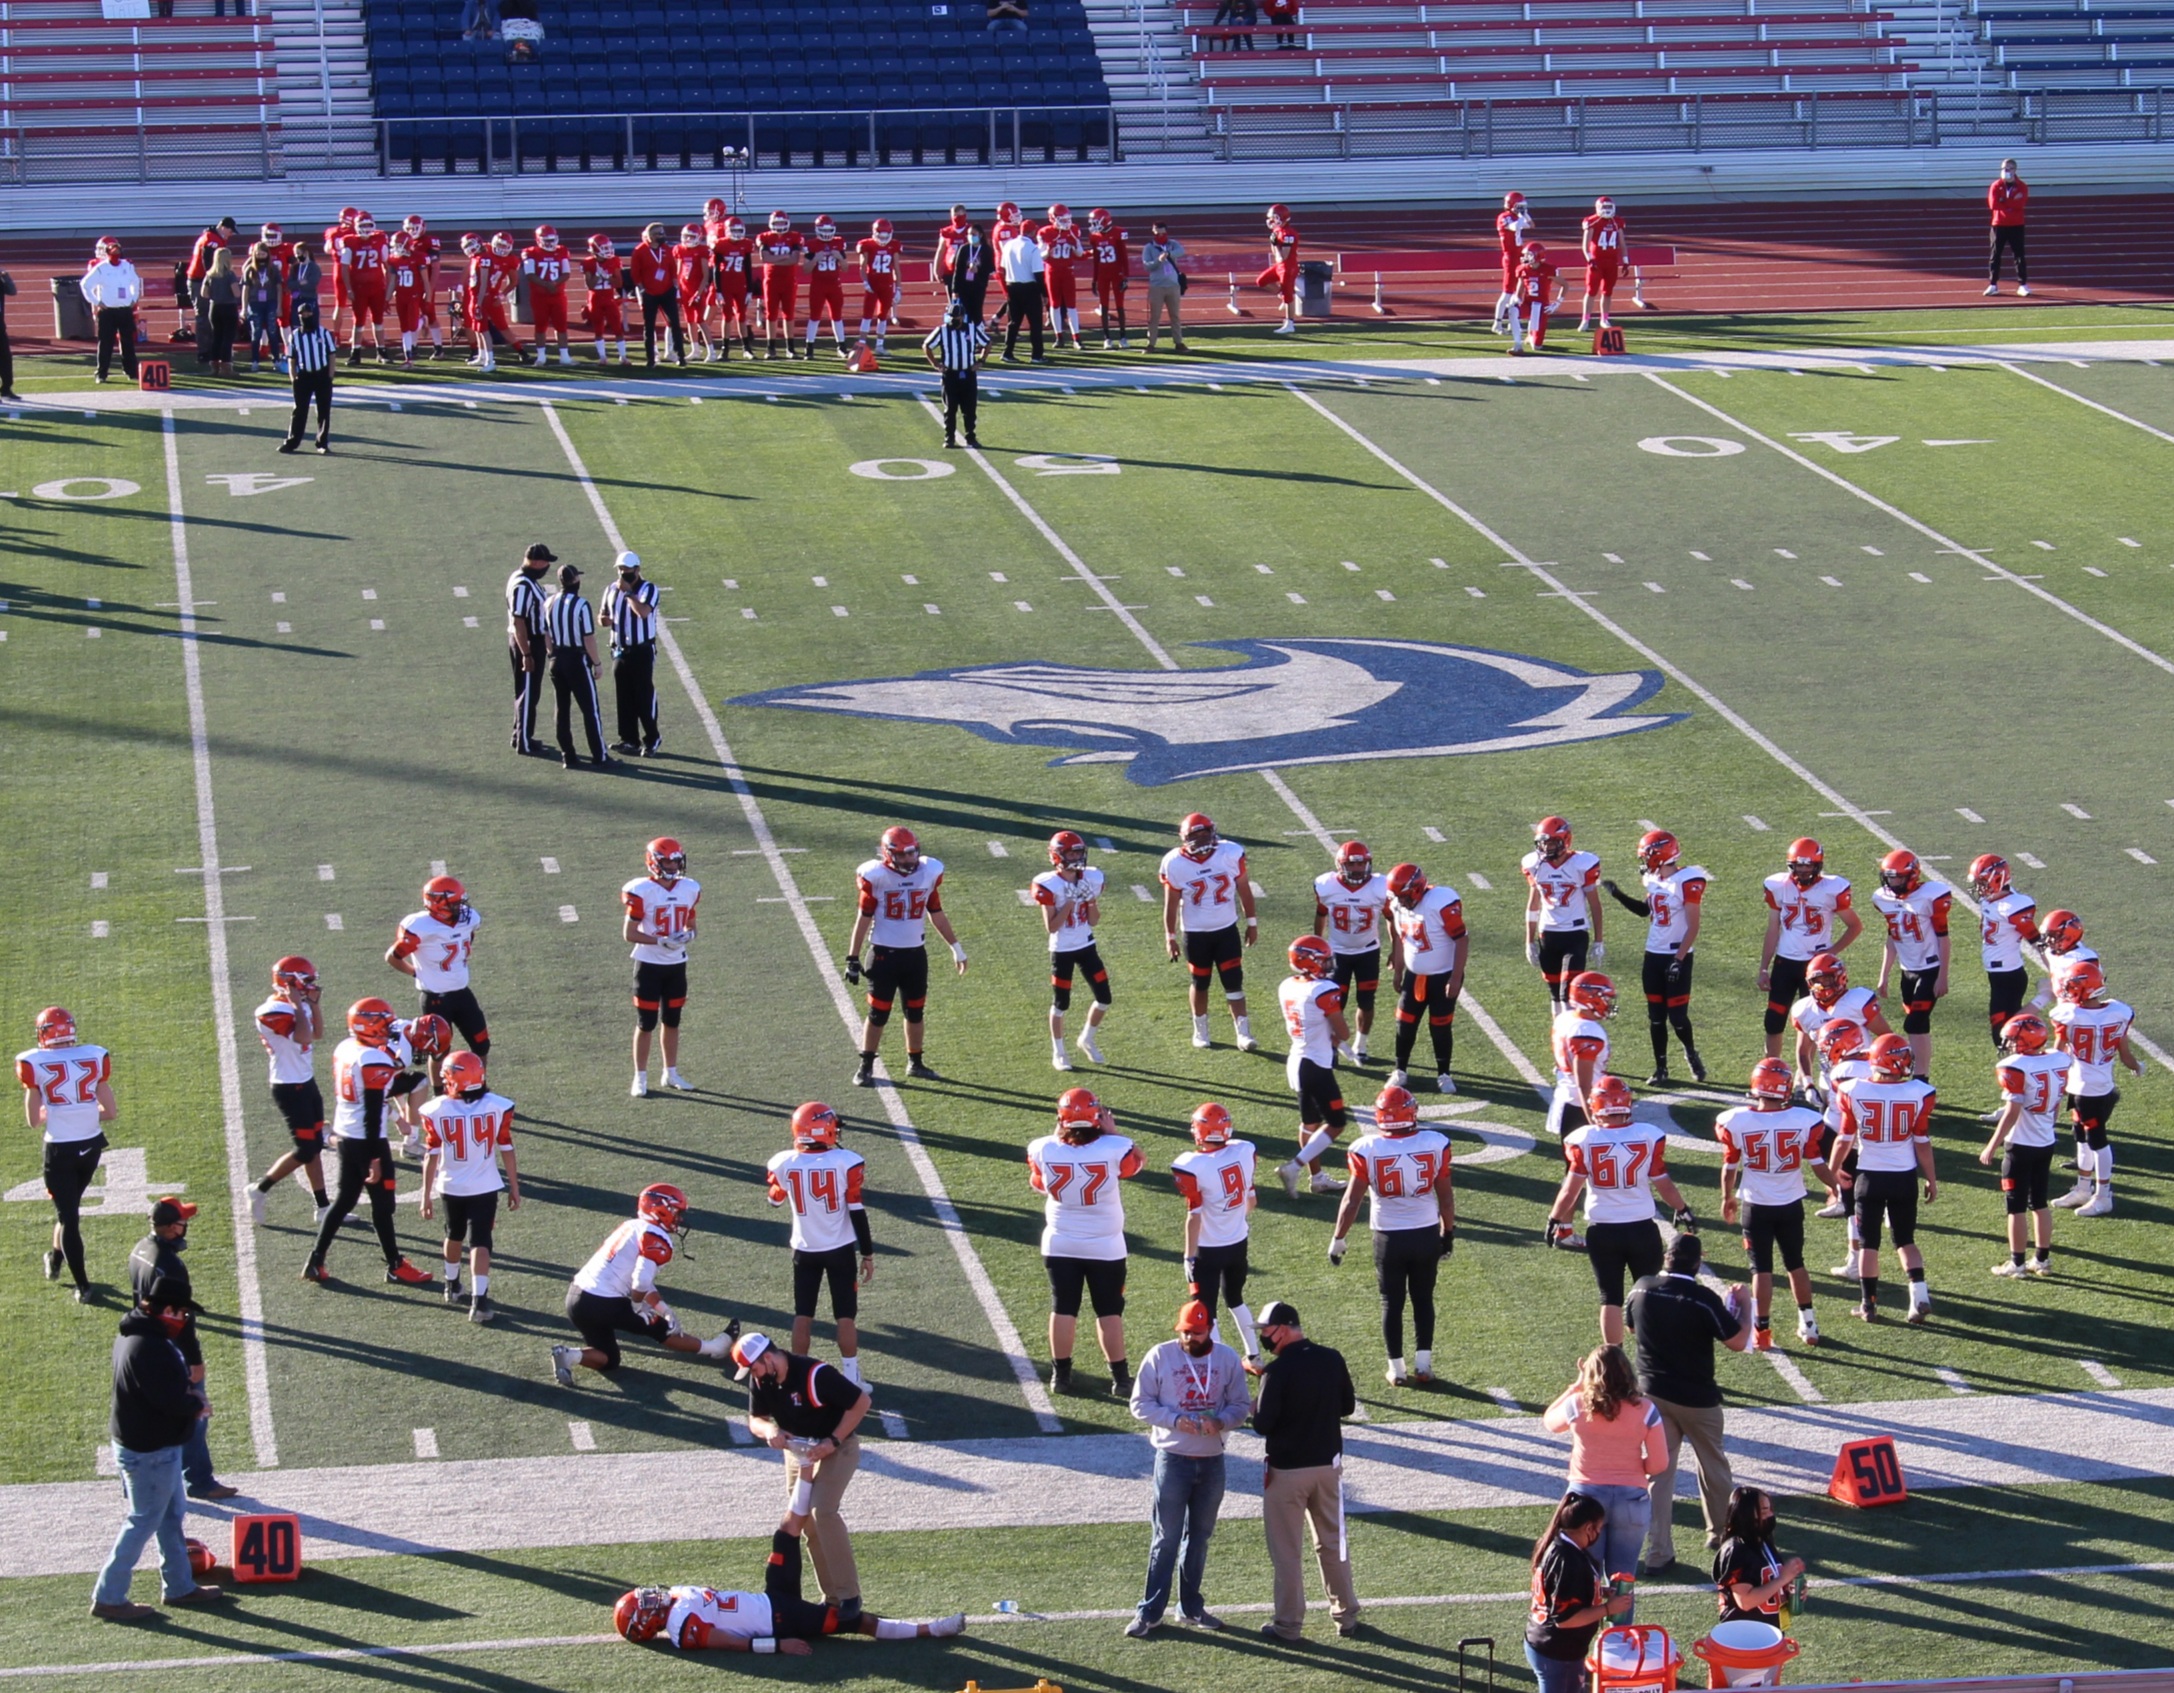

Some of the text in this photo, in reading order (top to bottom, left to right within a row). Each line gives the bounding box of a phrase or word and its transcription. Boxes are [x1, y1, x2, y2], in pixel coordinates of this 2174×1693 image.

[356, 250, 378, 269] 72
[1598, 231, 1617, 250] 44
[538, 262, 559, 281] 75
[872, 255, 892, 273] 42
[1601, 331, 1623, 352] 40
[143, 365, 168, 387] 40
[884, 889, 927, 920] 66
[1186, 873, 1230, 905] 72
[654, 904, 688, 936] 50
[1331, 905, 1374, 934] 83
[1781, 904, 1825, 935] 75
[2072, 1020, 2123, 1066] 85
[39, 1057, 100, 1105] 22
[440, 1112, 497, 1162] 44
[1857, 1099, 1918, 1143] 30
[1589, 1140, 1650, 1189] 67
[1742, 1129, 1802, 1173] 55
[786, 1168, 840, 1216] 14
[1046, 1161, 1109, 1206] 77
[1218, 1161, 1246, 1212] 9
[1374, 1151, 1436, 1199] 63
[1849, 1443, 1902, 1498] 50
[240, 1521, 295, 1575] 40
